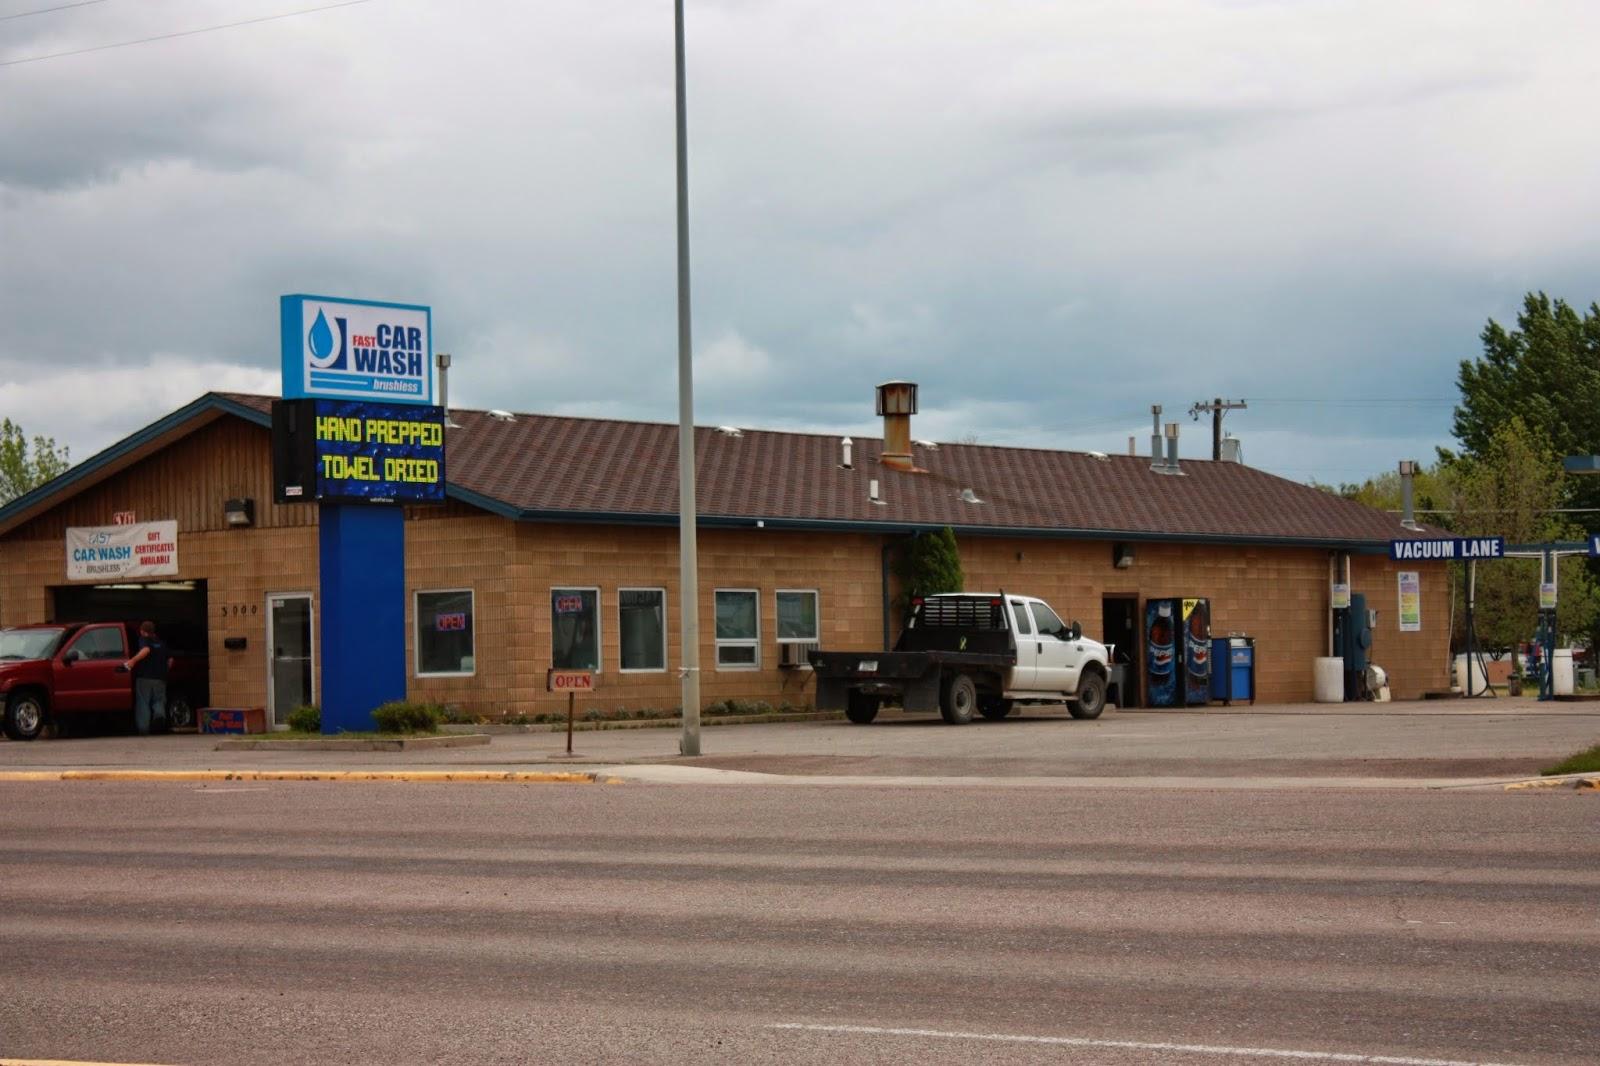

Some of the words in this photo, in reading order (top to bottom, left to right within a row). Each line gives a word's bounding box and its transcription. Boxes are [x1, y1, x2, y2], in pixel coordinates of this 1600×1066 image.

[352, 334, 376, 348] FAST
[377, 324, 421, 350] CAR
[354, 348, 422, 376] WASH
[373, 378, 418, 393] brushless
[316, 416, 362, 442] HAND
[366, 419, 443, 447] PREPPED
[322, 455, 381, 481] TOWEL
[384, 458, 439, 483] DRIED
[148, 532, 160, 541] GIFT
[74, 549, 96, 561] CAR
[98, 547, 130, 560] WASH
[135, 543, 174, 554] CERTIFICATES
[1395, 541, 1455, 559] VACUUM
[1461, 539, 1500, 557] LANE
[140, 556, 170, 565] AVAILABLE
[87, 565, 120, 573] BRUSHLESS
[436, 614, 465, 630] OPEN
[555, 674, 591, 688] OPEN
